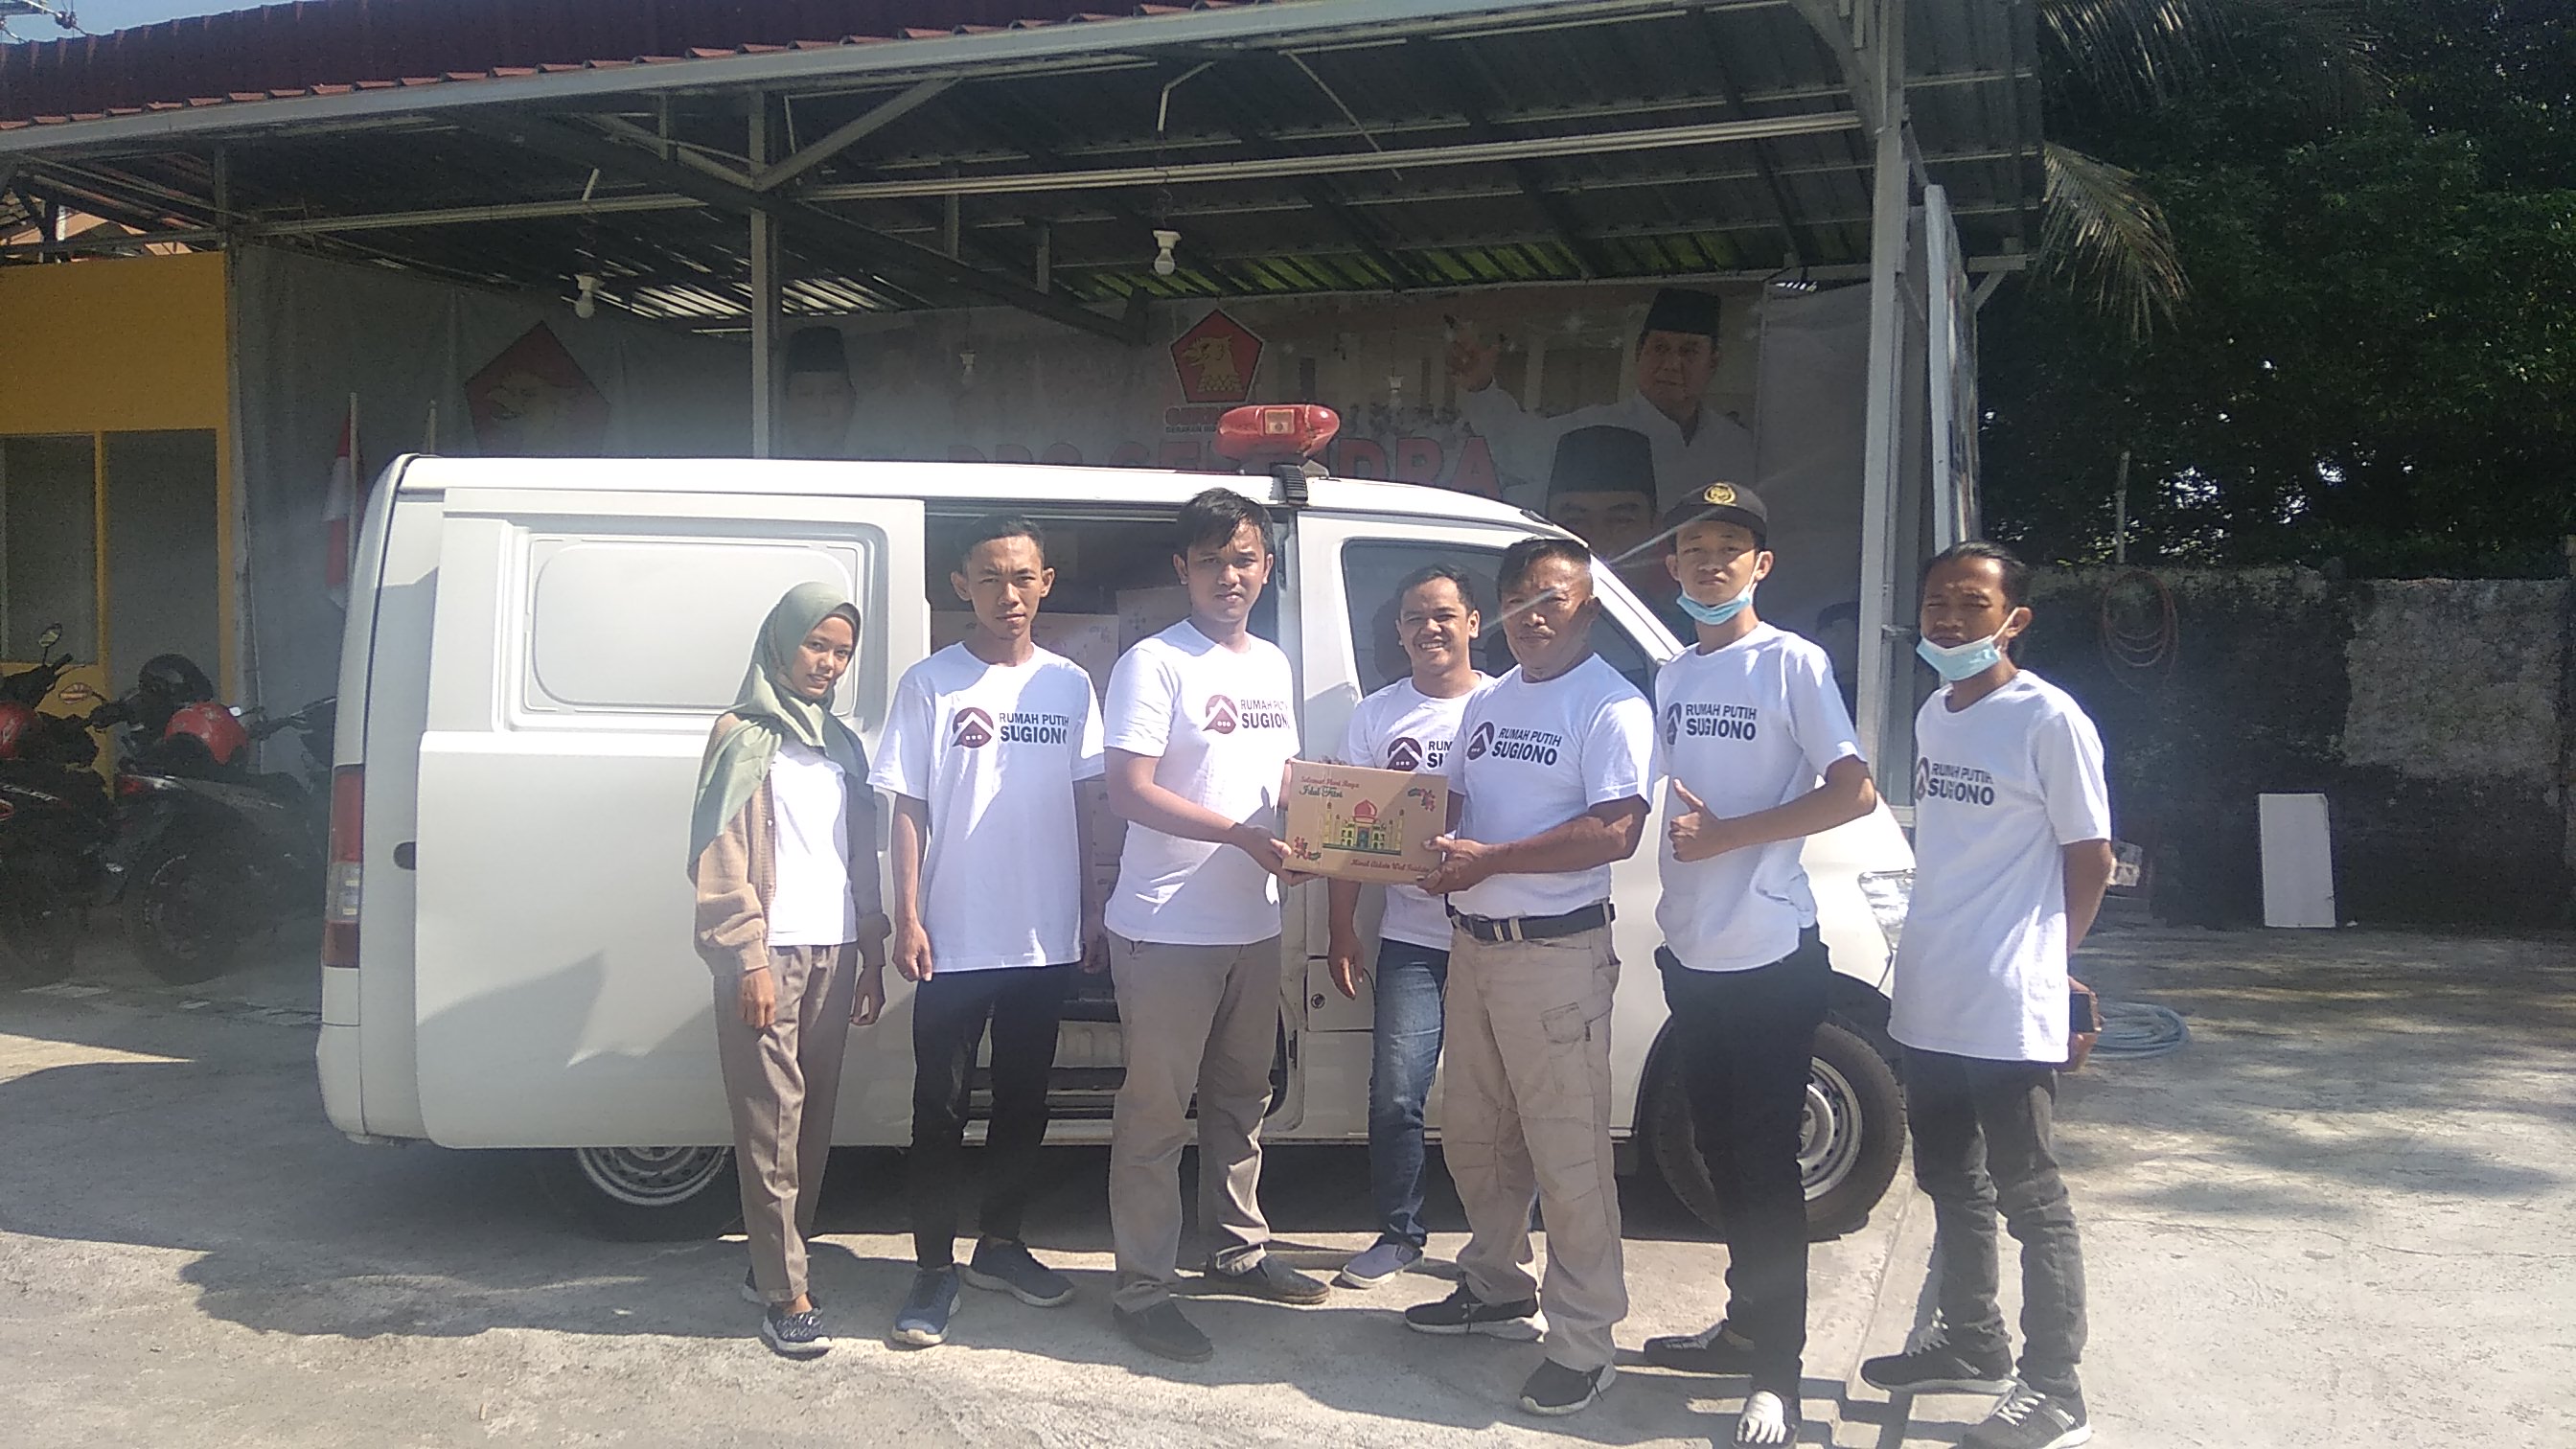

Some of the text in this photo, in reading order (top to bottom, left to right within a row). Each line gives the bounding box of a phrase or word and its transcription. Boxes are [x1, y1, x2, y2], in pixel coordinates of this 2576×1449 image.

[1240, 699, 1273, 711] RUMAH
[1686, 703, 1758, 721] RUMAH PUTIH
[999, 712, 1070, 727] RUMAH PUTIH
[1498, 727, 1563, 748] RUMAH PUTIH
[1686, 718, 1757, 741] SUGIONO
[1491, 741, 1558, 766] SUGIONO
